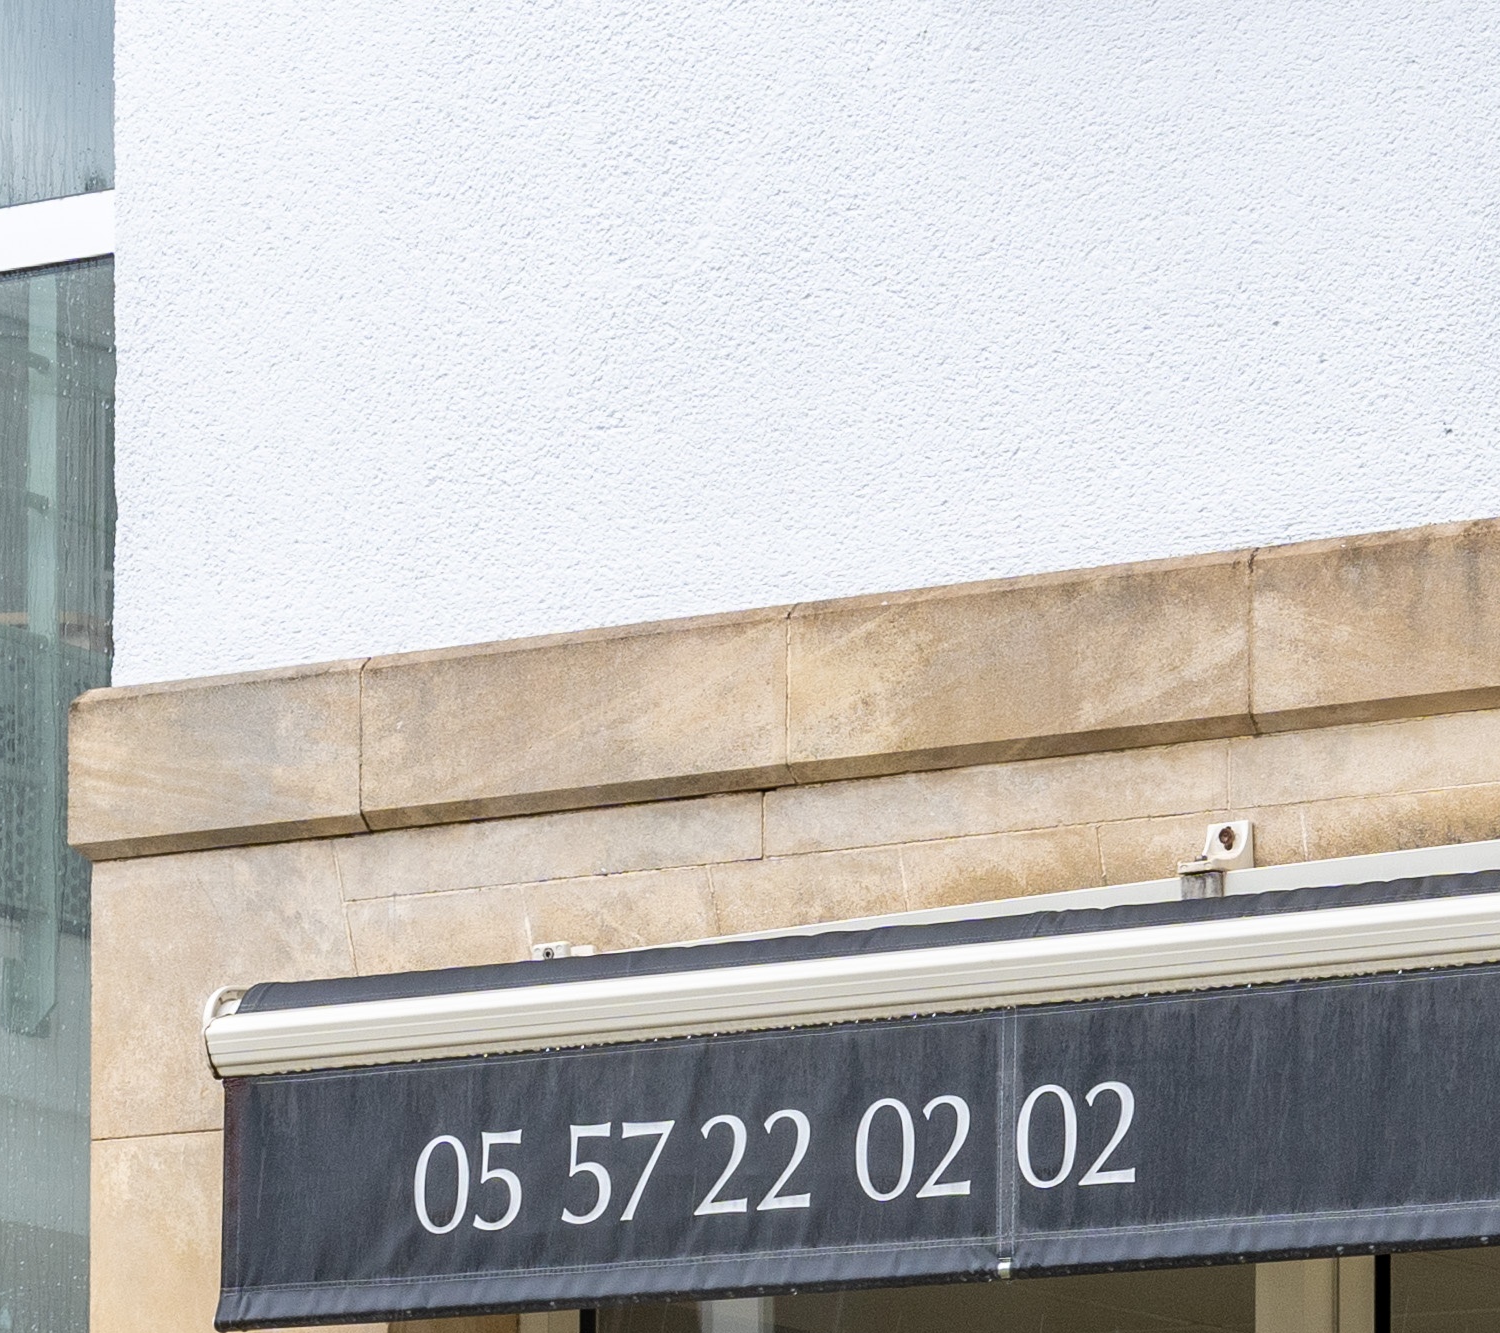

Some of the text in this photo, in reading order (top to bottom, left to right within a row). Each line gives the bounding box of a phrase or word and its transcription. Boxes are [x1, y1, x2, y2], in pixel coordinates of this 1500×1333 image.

[413, 1080, 1137, 1236] 05 57 22 02 02
